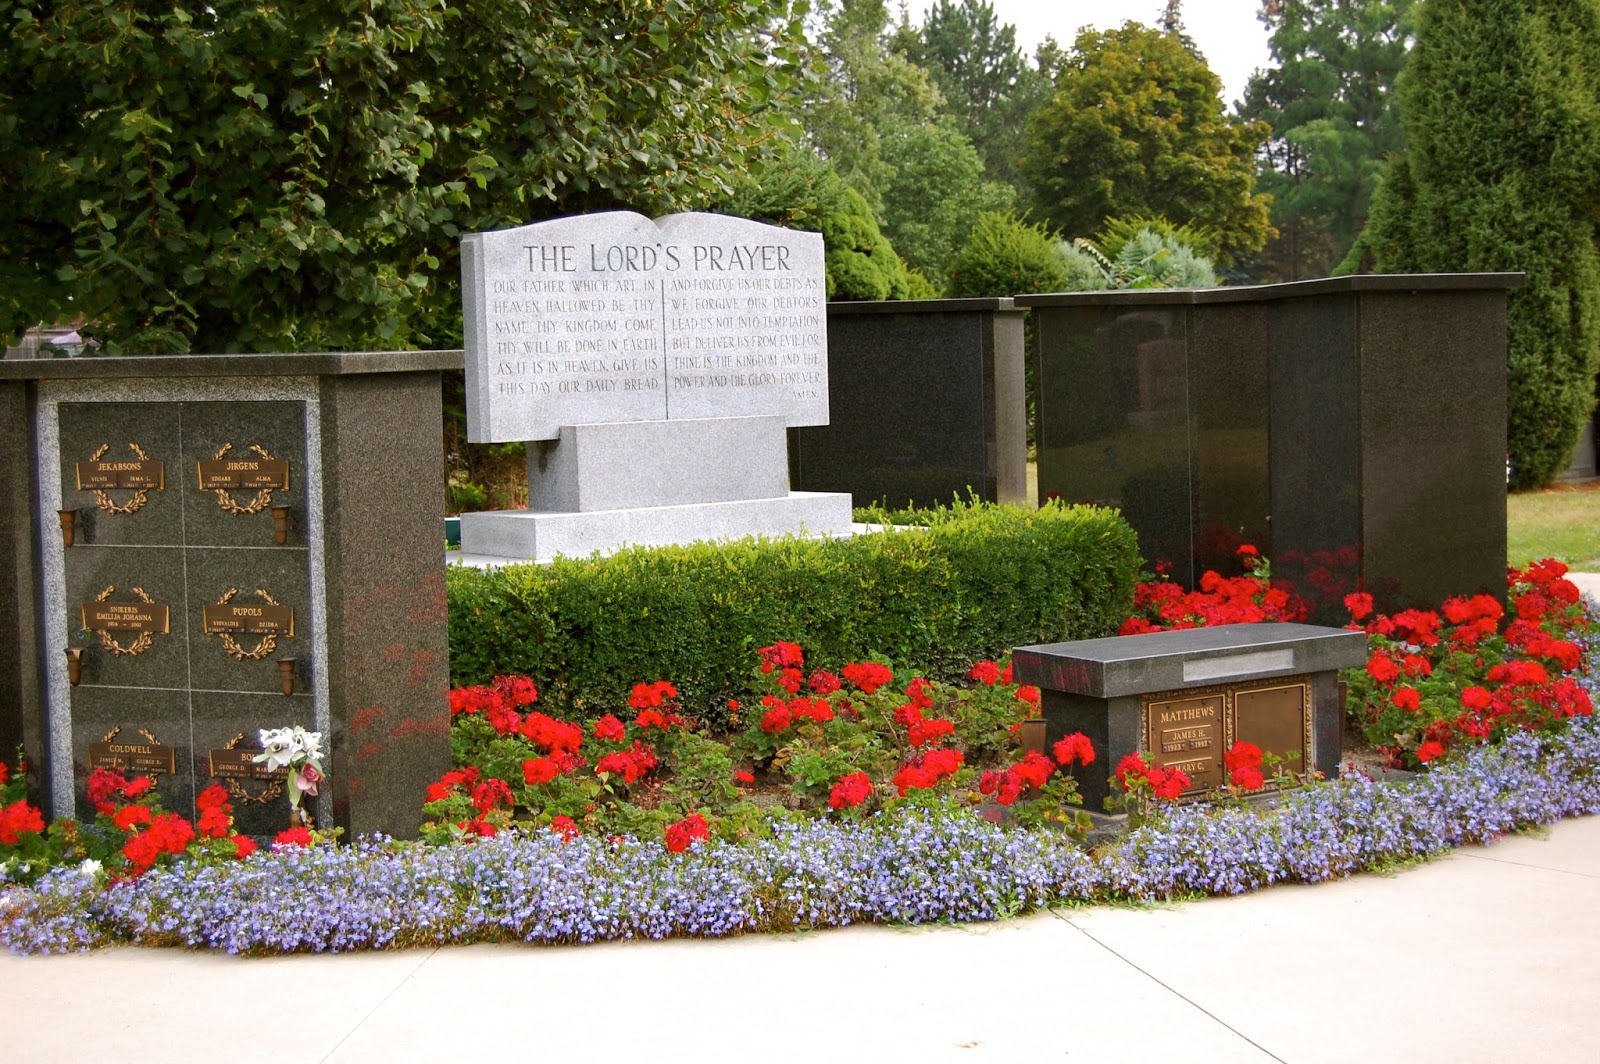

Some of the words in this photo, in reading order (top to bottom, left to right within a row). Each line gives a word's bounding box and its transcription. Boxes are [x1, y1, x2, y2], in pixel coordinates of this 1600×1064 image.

[523, 246, 577, 272] THE
[591, 243, 680, 272] LORD'S
[694, 245, 792, 271] PRAYER
[494, 280, 516, 293] OUR
[524, 280, 565, 293] FATHER
[571, 280, 608, 292] WHICH
[615, 279, 636, 292] ART
[644, 279, 655, 291] IN
[672, 279, 690, 291] AND
[694, 278, 734, 291] FORGIVE
[738, 278, 750, 290] US
[752, 278, 771, 290] OUR
[774, 278, 802, 290] DEBTS
[805, 277, 818, 289] AS
[494, 301, 539, 313] HEAVEN
[546, 300, 605, 313] HALLOWED
[612, 300, 625, 312] BE
[634, 299, 655, 311] THY
[672, 299, 687, 311] WE
[695, 298, 739, 310] FORGIVE
[747, 298, 767, 309] OUR
[773, 297, 818, 309] DEBTORS
[495, 321, 528, 334] NAME
[537, 321, 557, 333] THY
[566, 320, 617, 332] KINGDOM
[625, 319, 655, 331] COME
[672, 318, 698, 330] LEAD
[701, 318, 713, 329] US
[716, 317, 733, 329] NOT
[738, 317, 759, 329] INTO
[763, 316, 819, 328] TEMPTATION
[497, 341, 517, 354] THY
[524, 341, 549, 354] WILL
[557, 340, 570, 353] BE
[576, 340, 601, 352] DONE
[608, 339, 617, 351] IN
[623, 338, 657, 351] EARTH
[673, 338, 690, 350] BUT
[695, 337, 735, 349] DELIVER
[737, 336, 749, 348] US
[752, 335, 776, 348] FROM
[780, 335, 800, 346] EVIL
[802, 334, 819, 346] FOR
[498, 362, 512, 375] AS
[517, 362, 526, 374] IT
[533, 361, 543, 373] IS
[549, 361, 559, 373] IN
[613, 359, 640, 371] GIVE
[644, 358, 657, 370] US
[674, 357, 700, 370] THINE
[703, 356, 713, 369] IS
[715, 355, 733, 368] THE
[736, 354, 777, 367] KINGDOM
[780, 354, 799, 366] AND
[802, 353, 819, 366] THE
[499, 382, 525, 395] THIS
[531, 382, 551, 394] DAY
[559, 380, 581, 393] OUR
[587, 379, 618, 392] DAILY
[624, 378, 658, 390] BREAD
[674, 376, 705, 389] POWER
[708, 375, 727, 388] AND
[730, 375, 746, 387] THE
[749, 374, 776, 387] GLORY
[780, 372, 820, 385] FOREVER
[98, 463, 141, 471] JEKABSONS
[226, 462, 259, 470] JIRGENS
[110, 606, 138, 614] SNIKERIS
[122, 613, 152, 621] JOHANNA
[233, 608, 262, 616] PUPOLS
[1161, 706, 1214, 723] MATTHEWS
[1172, 730, 1196, 741] JAMES
[1198, 730, 1206, 738] H.
[109, 745, 152, 754] COLDWELL
[1175, 763, 1196, 772] MARY
[1197, 762, 1204, 770] C.
